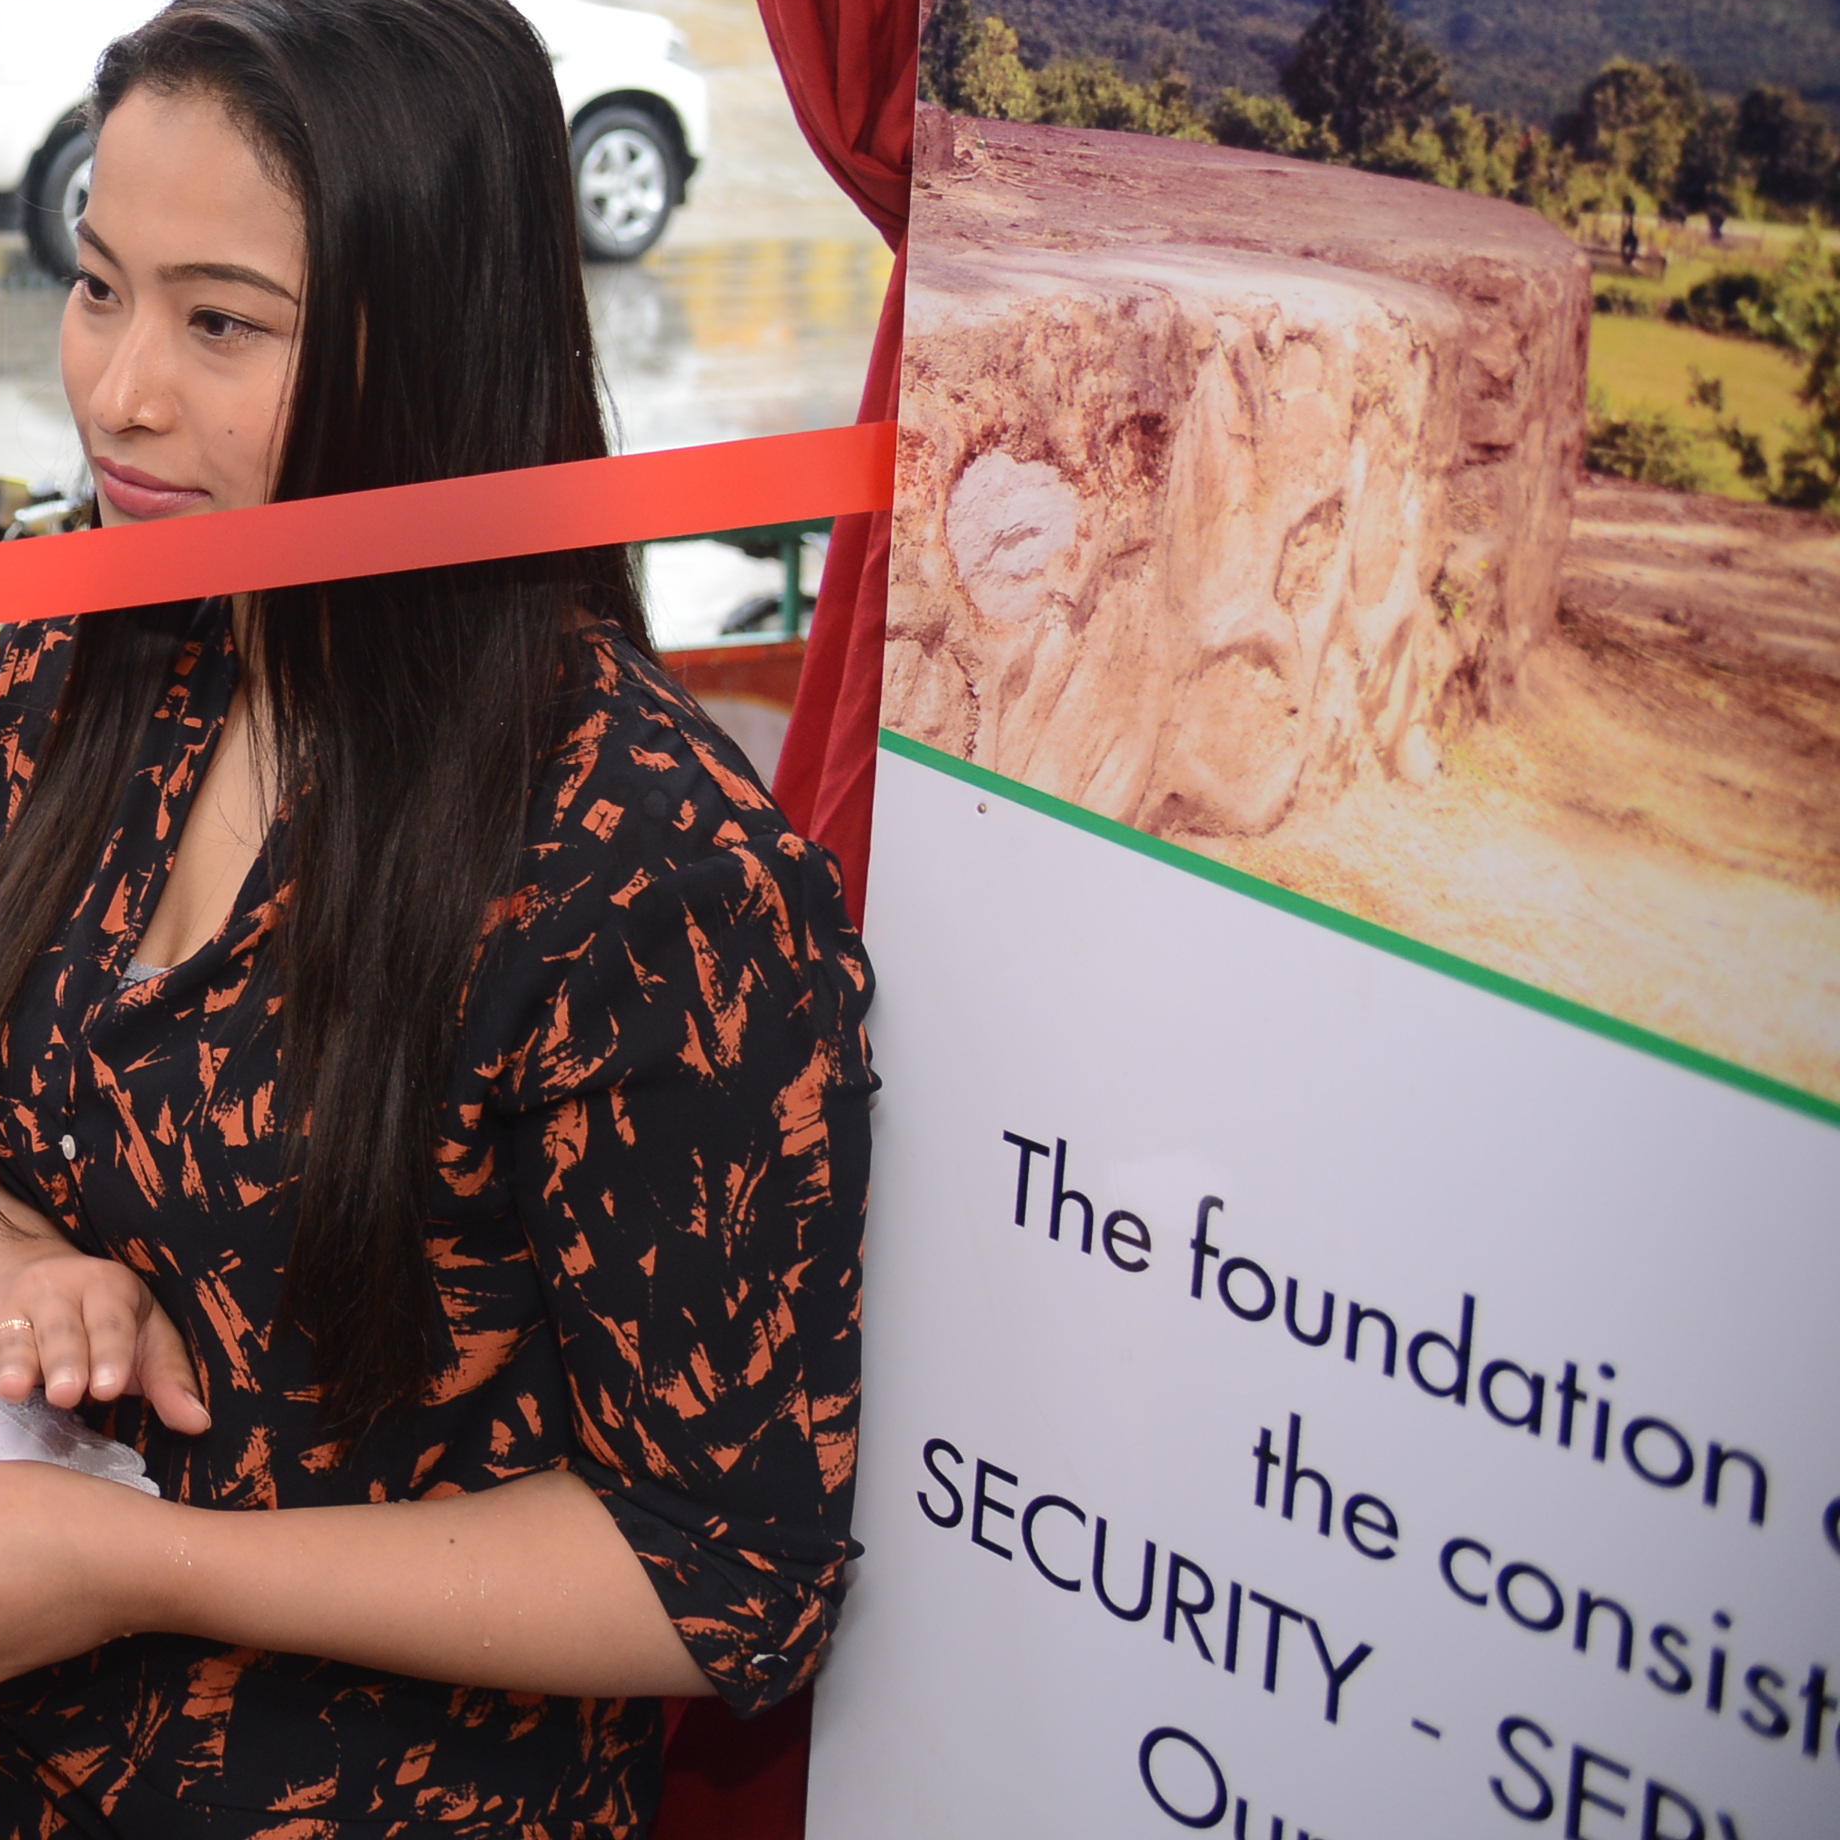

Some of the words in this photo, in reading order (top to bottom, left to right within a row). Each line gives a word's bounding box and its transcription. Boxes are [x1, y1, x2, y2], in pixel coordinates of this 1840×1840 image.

[1002, 1129, 1152, 1273] The
[1189, 1195, 1769, 1528] foundation
[917, 1437, 1373, 1725] SECURITY
[1252, 1413, 1400, 1561] the
[1438, 1536, 1840, 1760] consist
